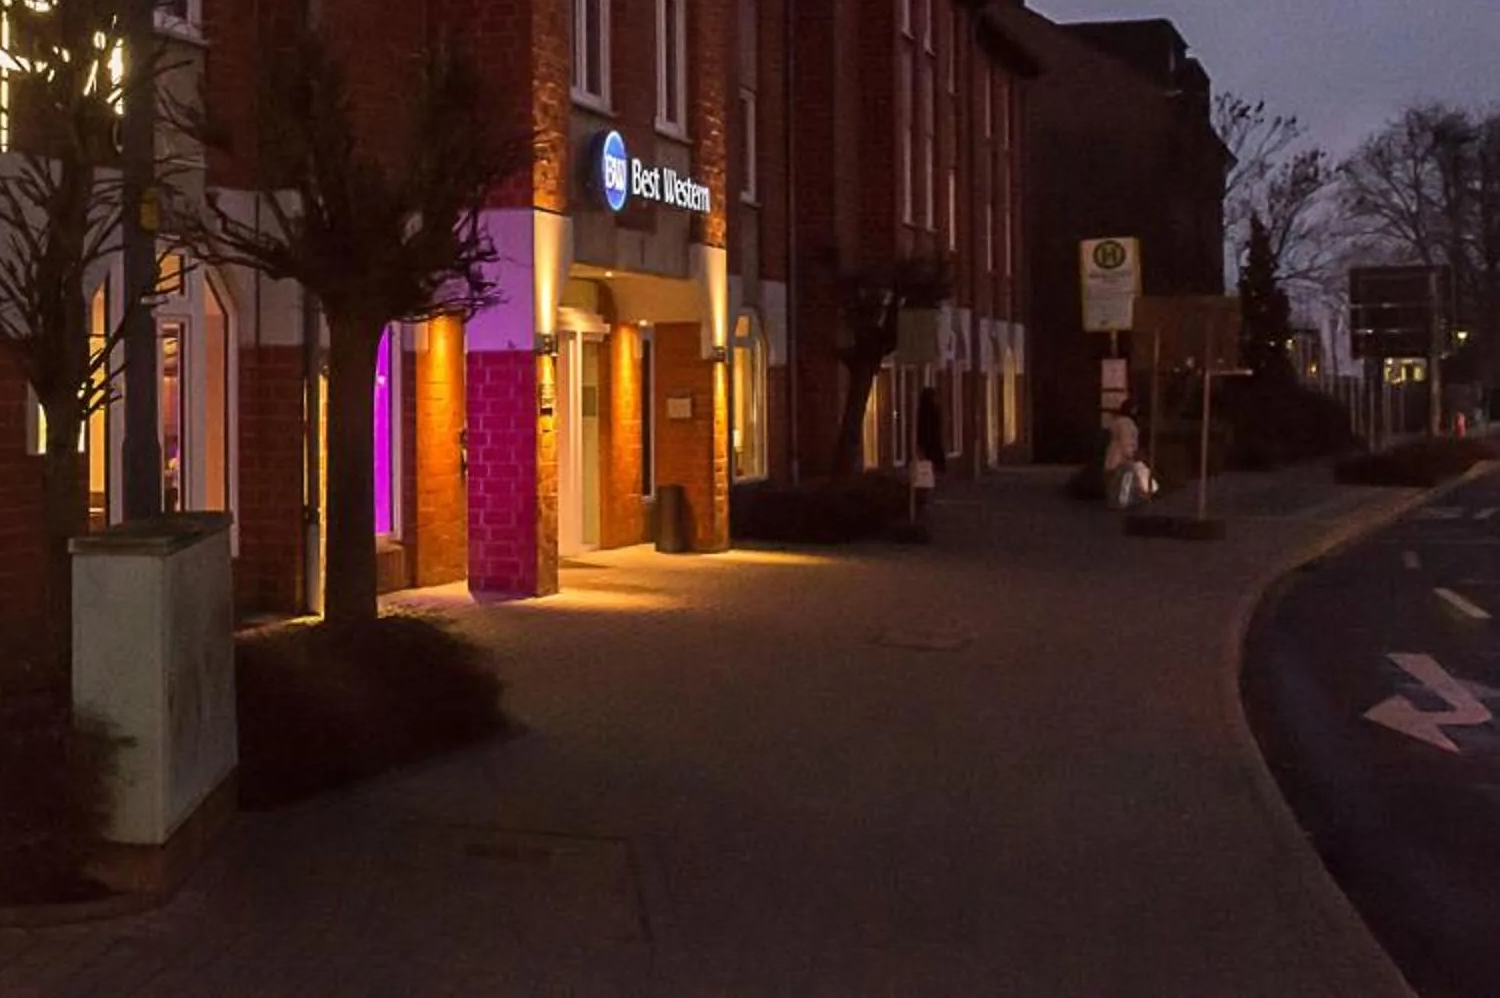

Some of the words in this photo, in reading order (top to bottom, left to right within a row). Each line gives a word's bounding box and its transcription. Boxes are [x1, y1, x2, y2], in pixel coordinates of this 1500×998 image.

[605, 154, 627, 191] BW
[632, 158, 660, 201] Best
[663, 167, 711, 213] Western
